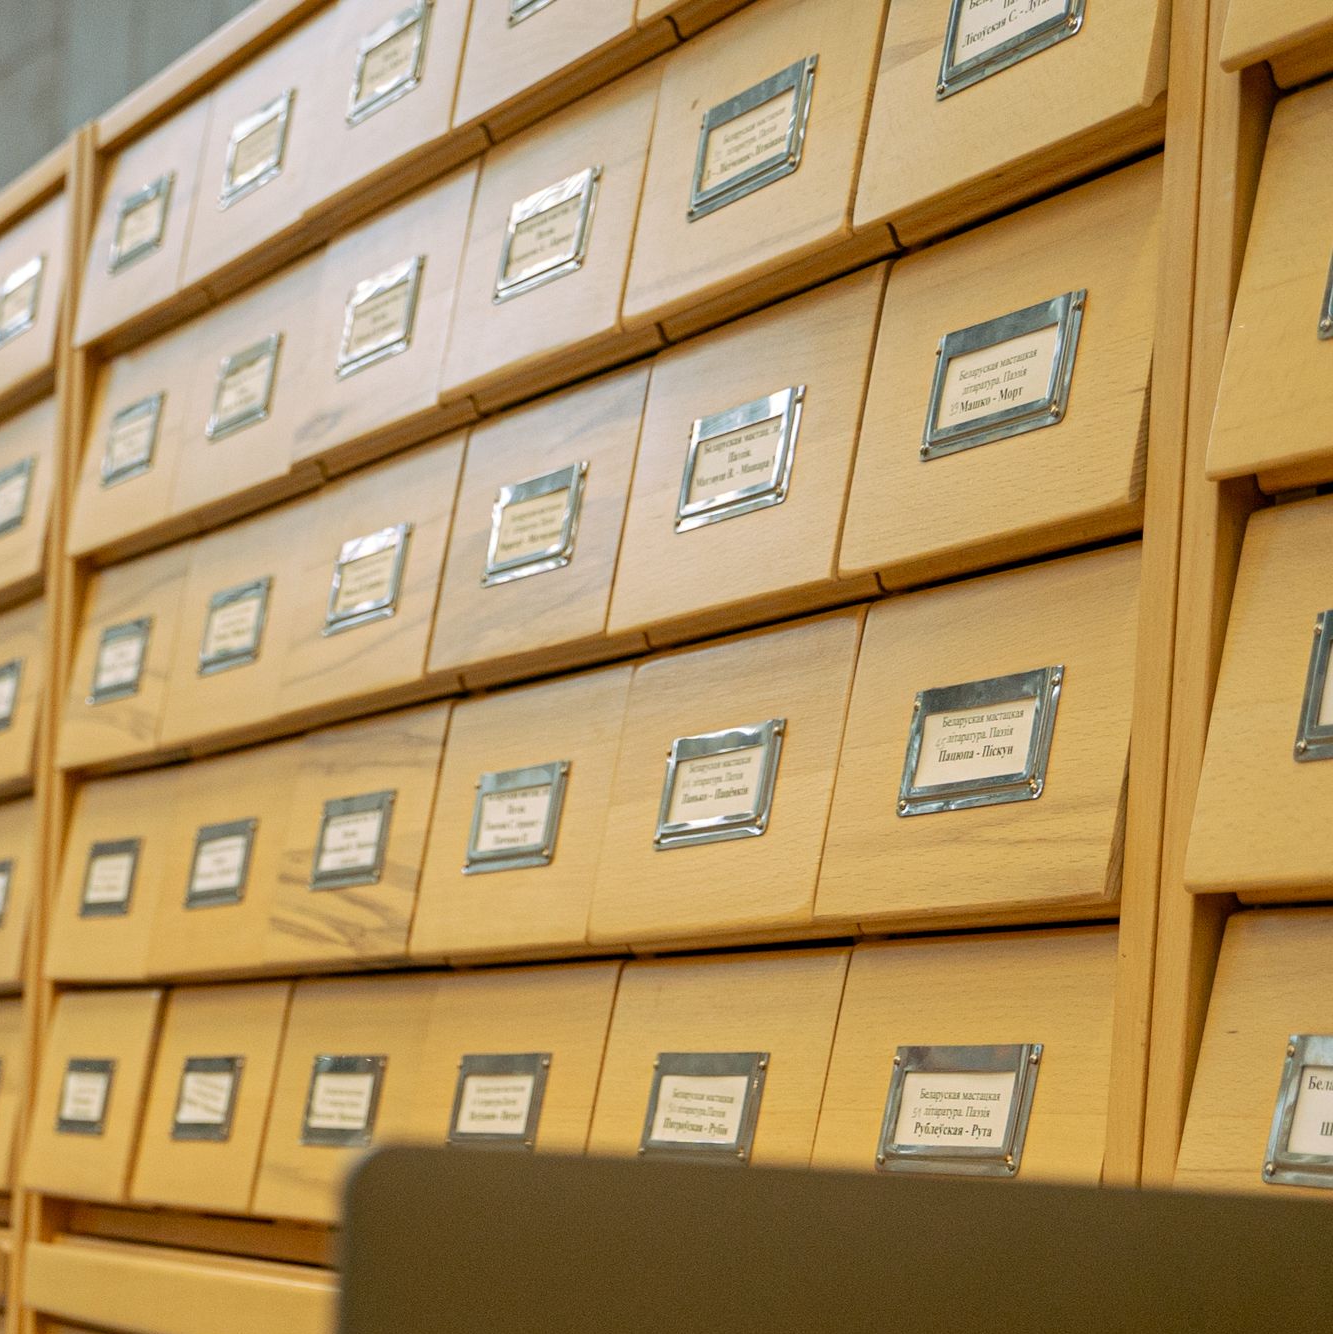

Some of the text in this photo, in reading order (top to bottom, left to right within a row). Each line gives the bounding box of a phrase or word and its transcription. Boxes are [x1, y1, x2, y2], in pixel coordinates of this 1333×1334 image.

[962, 18, 1006, 48] Лісоўская
[960, 350, 1038, 381] Беларуская мастацкая
[960, 398, 991, 414] Машко
[999, 387, 1024, 402] Морт
[943, 710, 1024, 729] Беларуская мастацкая
[990, 726, 1014, 739] Паэзія
[939, 750, 974, 762] Пацюпа
[983, 745, 1014, 758] Піскун
[921, 1089, 1000, 1102] Беларуская мастацкая
[966, 1107, 990, 1118] Паэзія
[914, 1123, 963, 1138] Рублеўская
[972, 1125, 992, 1139] Рута
